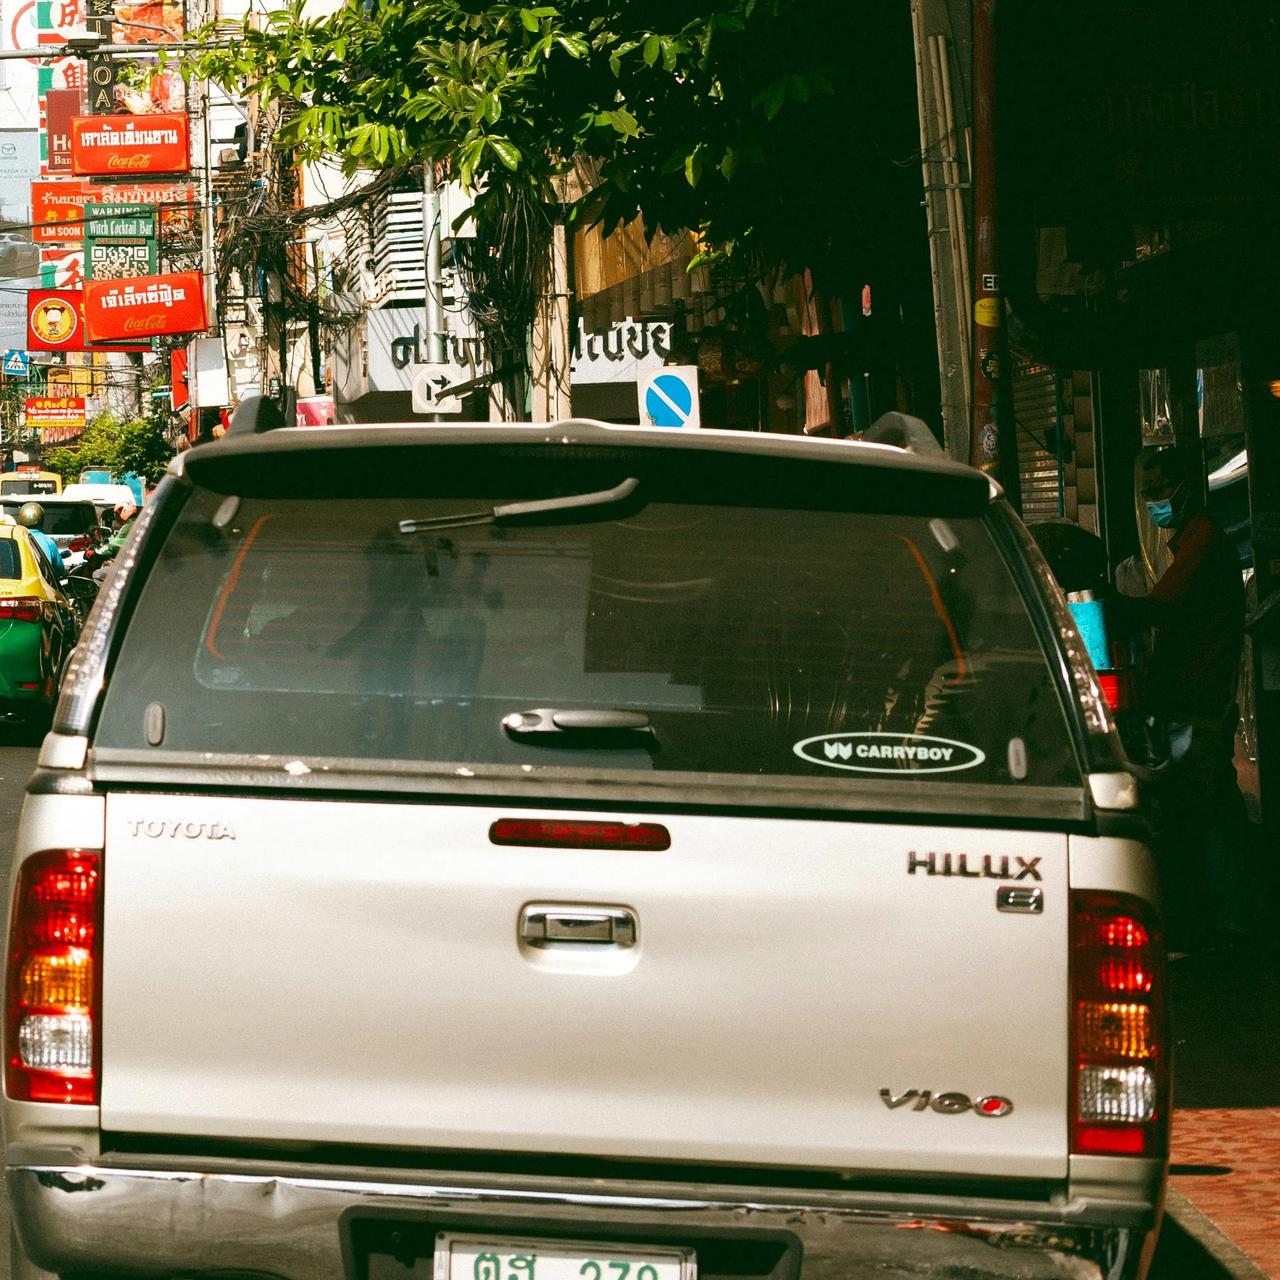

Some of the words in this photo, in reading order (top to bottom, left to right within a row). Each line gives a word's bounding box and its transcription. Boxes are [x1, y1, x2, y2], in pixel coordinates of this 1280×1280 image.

[107, 152, 153, 169] Coca-Cola
[92, 207, 140, 217] WARNING
[41, 226, 56, 237] LIM
[57, 226, 82, 237] SOON
[90, 220, 109, 235] Witch
[110, 220, 137, 236] Cocktail
[139, 220, 153, 236] Bar
[123, 314, 167, 333] Coca-Cola
[856, 743, 953, 761] CARRYBOY
[128, 819, 237, 840] TOYOTA
[906, 851, 1043, 881] HILUX
[879, 1088, 1015, 1118] VIGO
